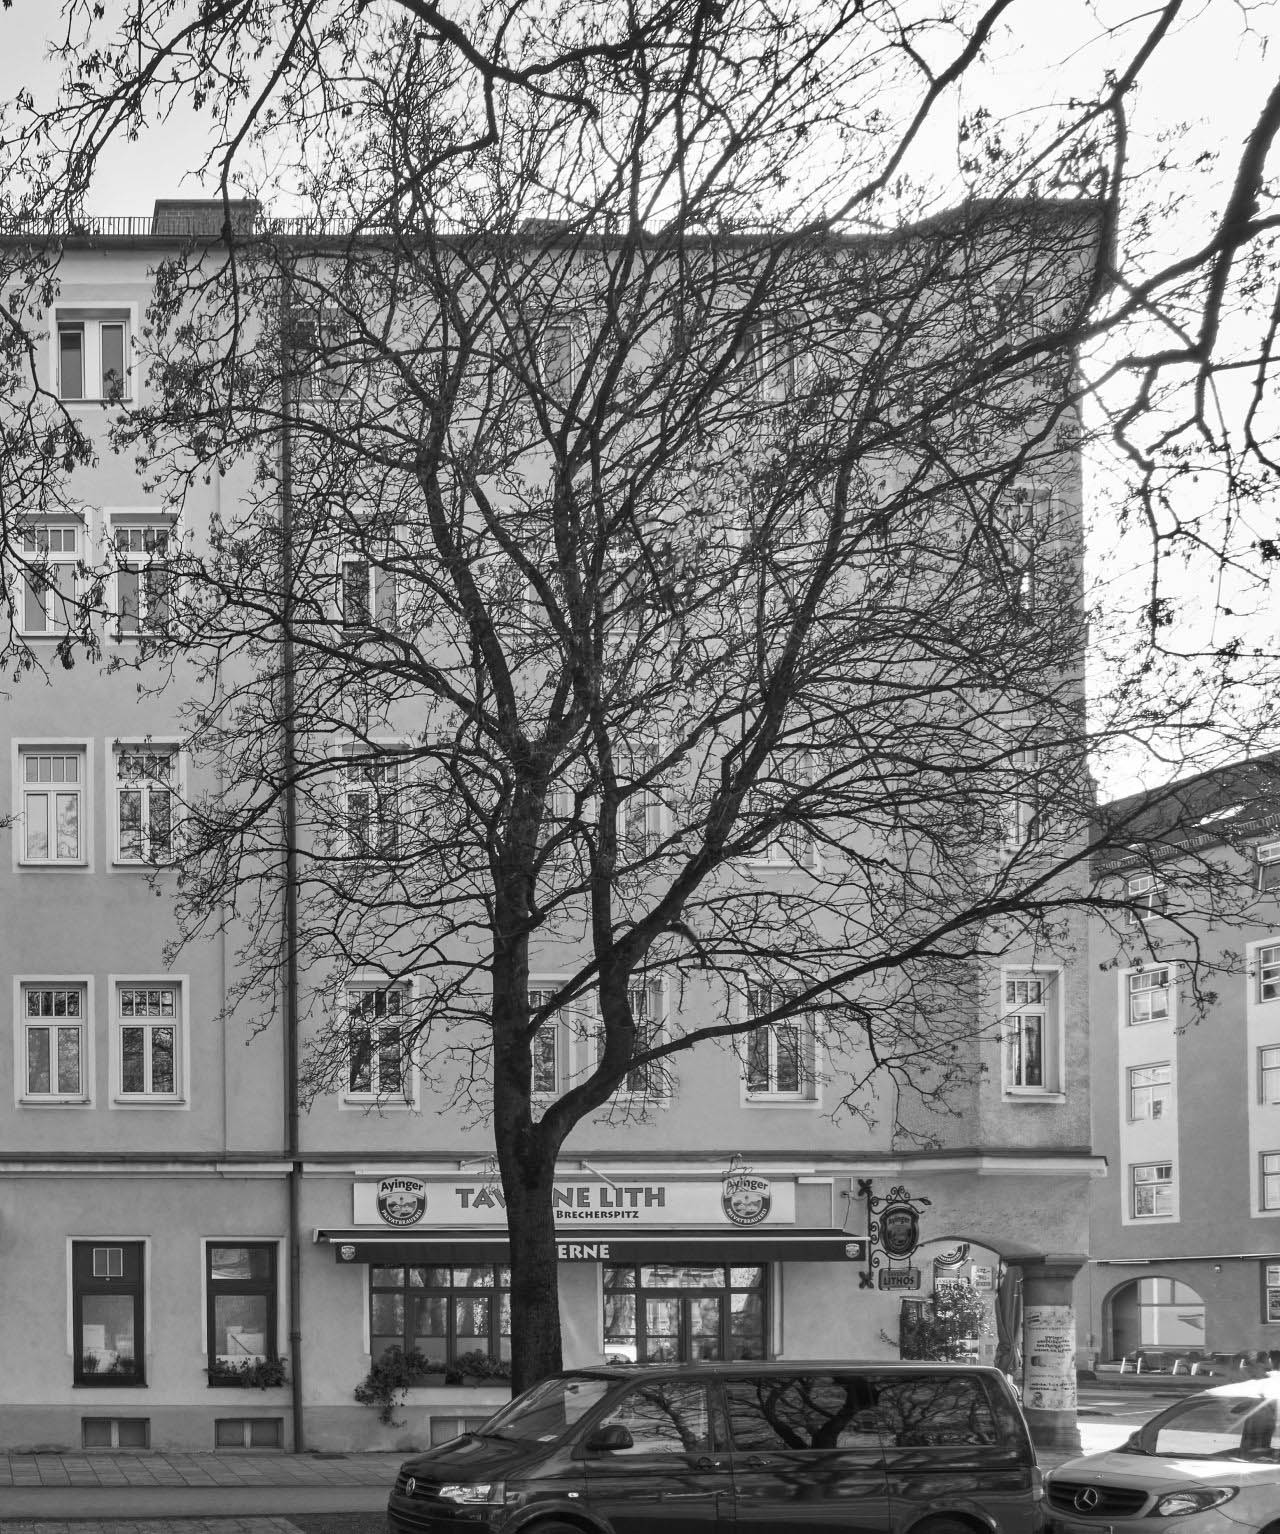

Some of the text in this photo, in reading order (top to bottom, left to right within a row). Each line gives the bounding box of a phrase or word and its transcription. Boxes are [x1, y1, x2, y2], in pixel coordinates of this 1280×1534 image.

[380, 1179, 423, 1192] Ayinger
[455, 1187, 665, 1208] TAVNE LITH
[556, 1210, 639, 1219] BRECHERSPITZ
[557, 1244, 610, 1259] ERNE
[883, 1276, 914, 1285] LITHOS
